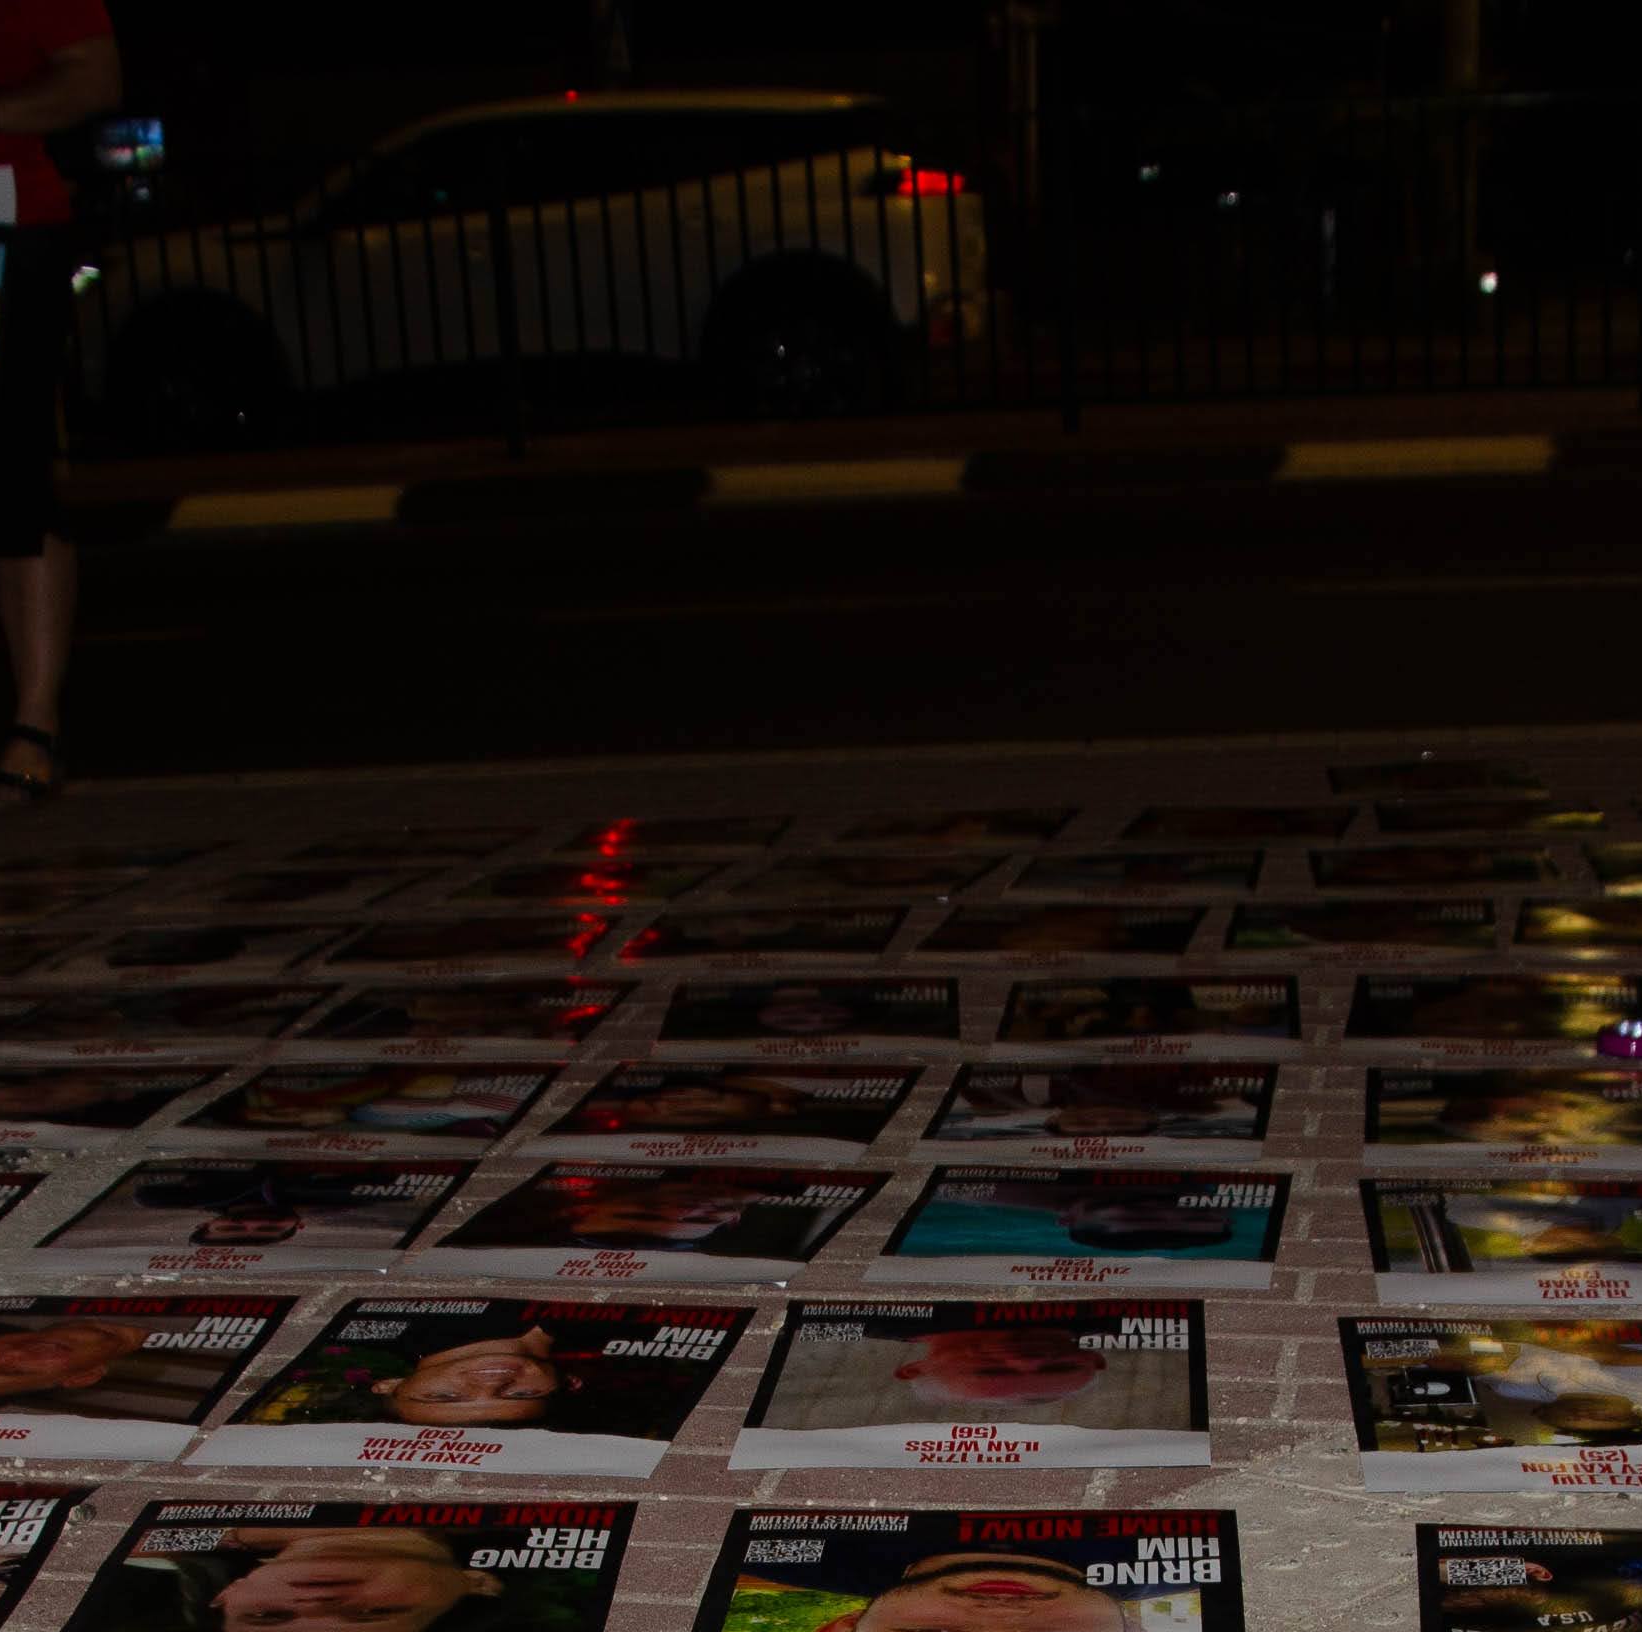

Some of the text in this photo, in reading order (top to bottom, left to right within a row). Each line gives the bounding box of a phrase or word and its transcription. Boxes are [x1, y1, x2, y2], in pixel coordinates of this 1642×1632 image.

[415, 1428, 465, 1441] (30)
[951, 1425, 998, 1440] (56)
[363, 1438, 502, 1454] ORON SHAUL
[904, 1440, 1039, 1453] ILAN WEISS
[1579, 1448, 1629, 1464] (25)
[525, 1527, 611, 1548] HER
[1136, 1537, 1220, 1560] HIM
[469, 1547, 606, 1570] BRING
[1086, 1558, 1221, 1584] BRING
